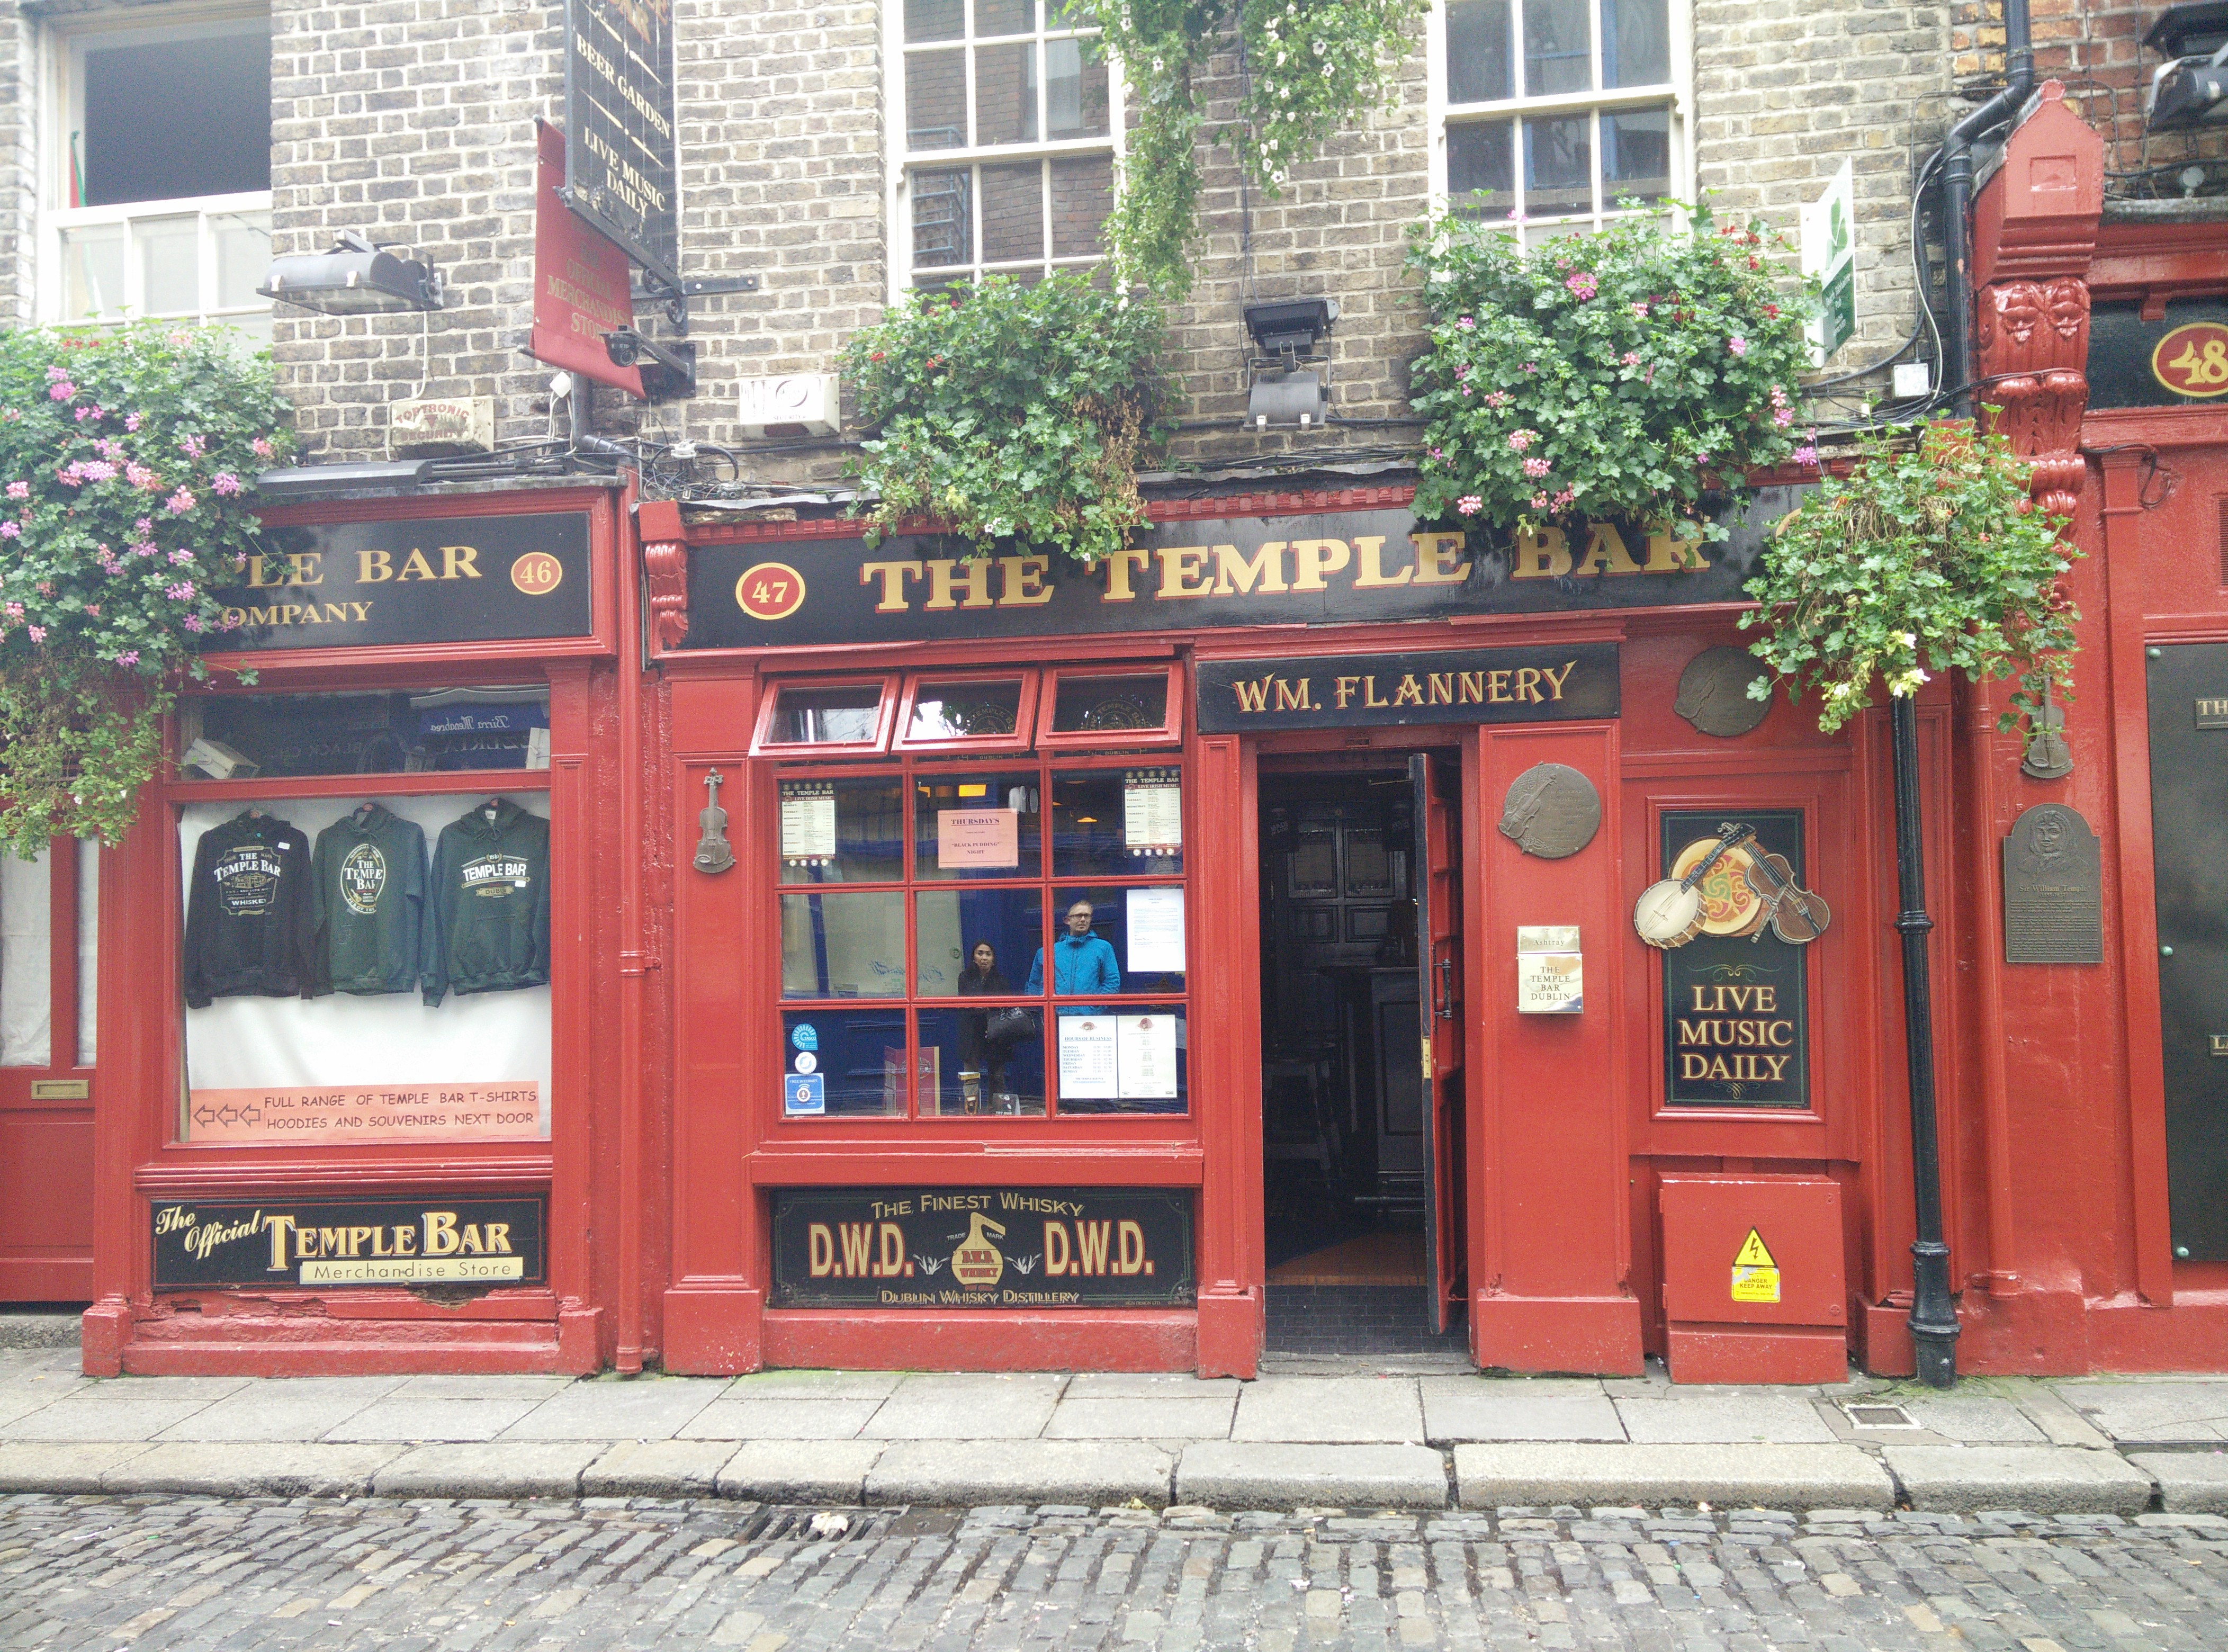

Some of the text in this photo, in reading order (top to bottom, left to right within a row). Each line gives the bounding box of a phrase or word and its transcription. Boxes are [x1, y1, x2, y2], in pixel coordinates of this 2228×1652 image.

[577, 32, 615, 85] BEER
[618, 76, 670, 139] GARDEN
[585, 126, 665, 211] LIVE MUSIC
[607, 168, 648, 218] DAILY
[571, 312, 610, 344] STOR
[2169, 340, 2228, 385] 48
[354, 545, 482, 585] BAR
[520, 561, 552, 585] 46
[860, 518, 1711, 613] THE TEMPLE BAR
[752, 580, 788, 603] 47
[222, 601, 373, 626] OMPANY
[1233, 659, 1578, 713] WM. FLANNERY
[214, 859, 281, 882] TEMPLE BAR
[344, 868, 383, 880] TEMPE
[357, 860, 374, 869] THE
[463, 864, 504, 882] TEMPLE
[505, 863, 527, 876] BAR
[1533, 938, 1565, 947] Ashtray
[1693, 985, 1777, 1013] LIVE
[1677, 1019, 1793, 1048] MUSIC
[1681, 1053, 1790, 1082] DAILY
[264, 1090, 537, 1108] FULL RANGE OF TEMPLE BAR T-SHIRTS
[267, 1112, 534, 1129] HOODIES AND SOUVENIRS NEXT DOOR
[155, 1205, 196, 1235] The
[184, 1209, 261, 1260] Official
[947, 1232, 966, 1241] TRADE
[1044, 1219, 1155, 1277] D.W.D.
[808, 1222, 915, 1279] D.W.D.
[315, 1261, 511, 1279] Merchandise Store
[959, 1268, 998, 1278] WHISKY
